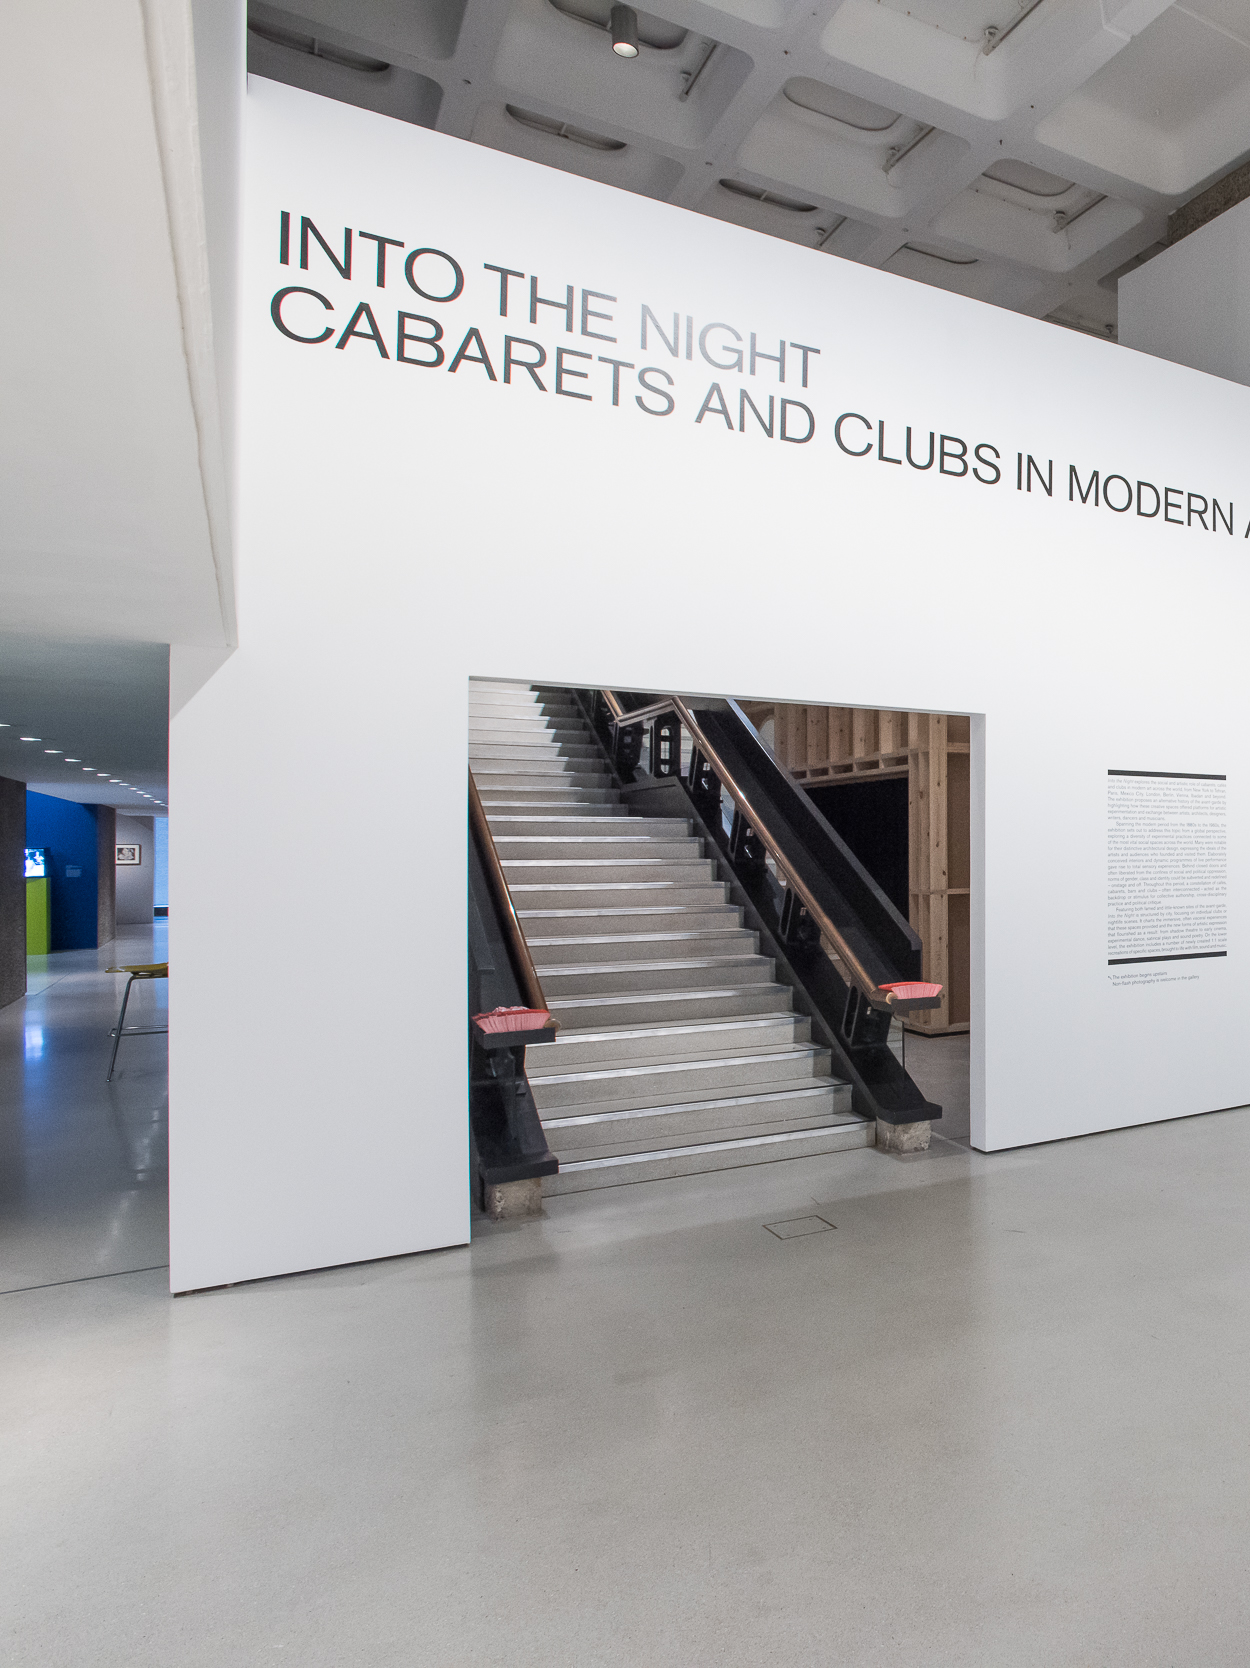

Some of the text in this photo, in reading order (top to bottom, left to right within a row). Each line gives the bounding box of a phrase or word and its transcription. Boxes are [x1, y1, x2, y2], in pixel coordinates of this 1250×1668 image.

[279, 210, 821, 389] INTO THE NIGHT
[270, 286, 676, 417] CABARETS
[695, 382, 816, 445] AND
[834, 412, 1001, 486] CLUBS
[1017, 452, 1053, 497] IN
[1069, 464, 1234, 536] MODERN
